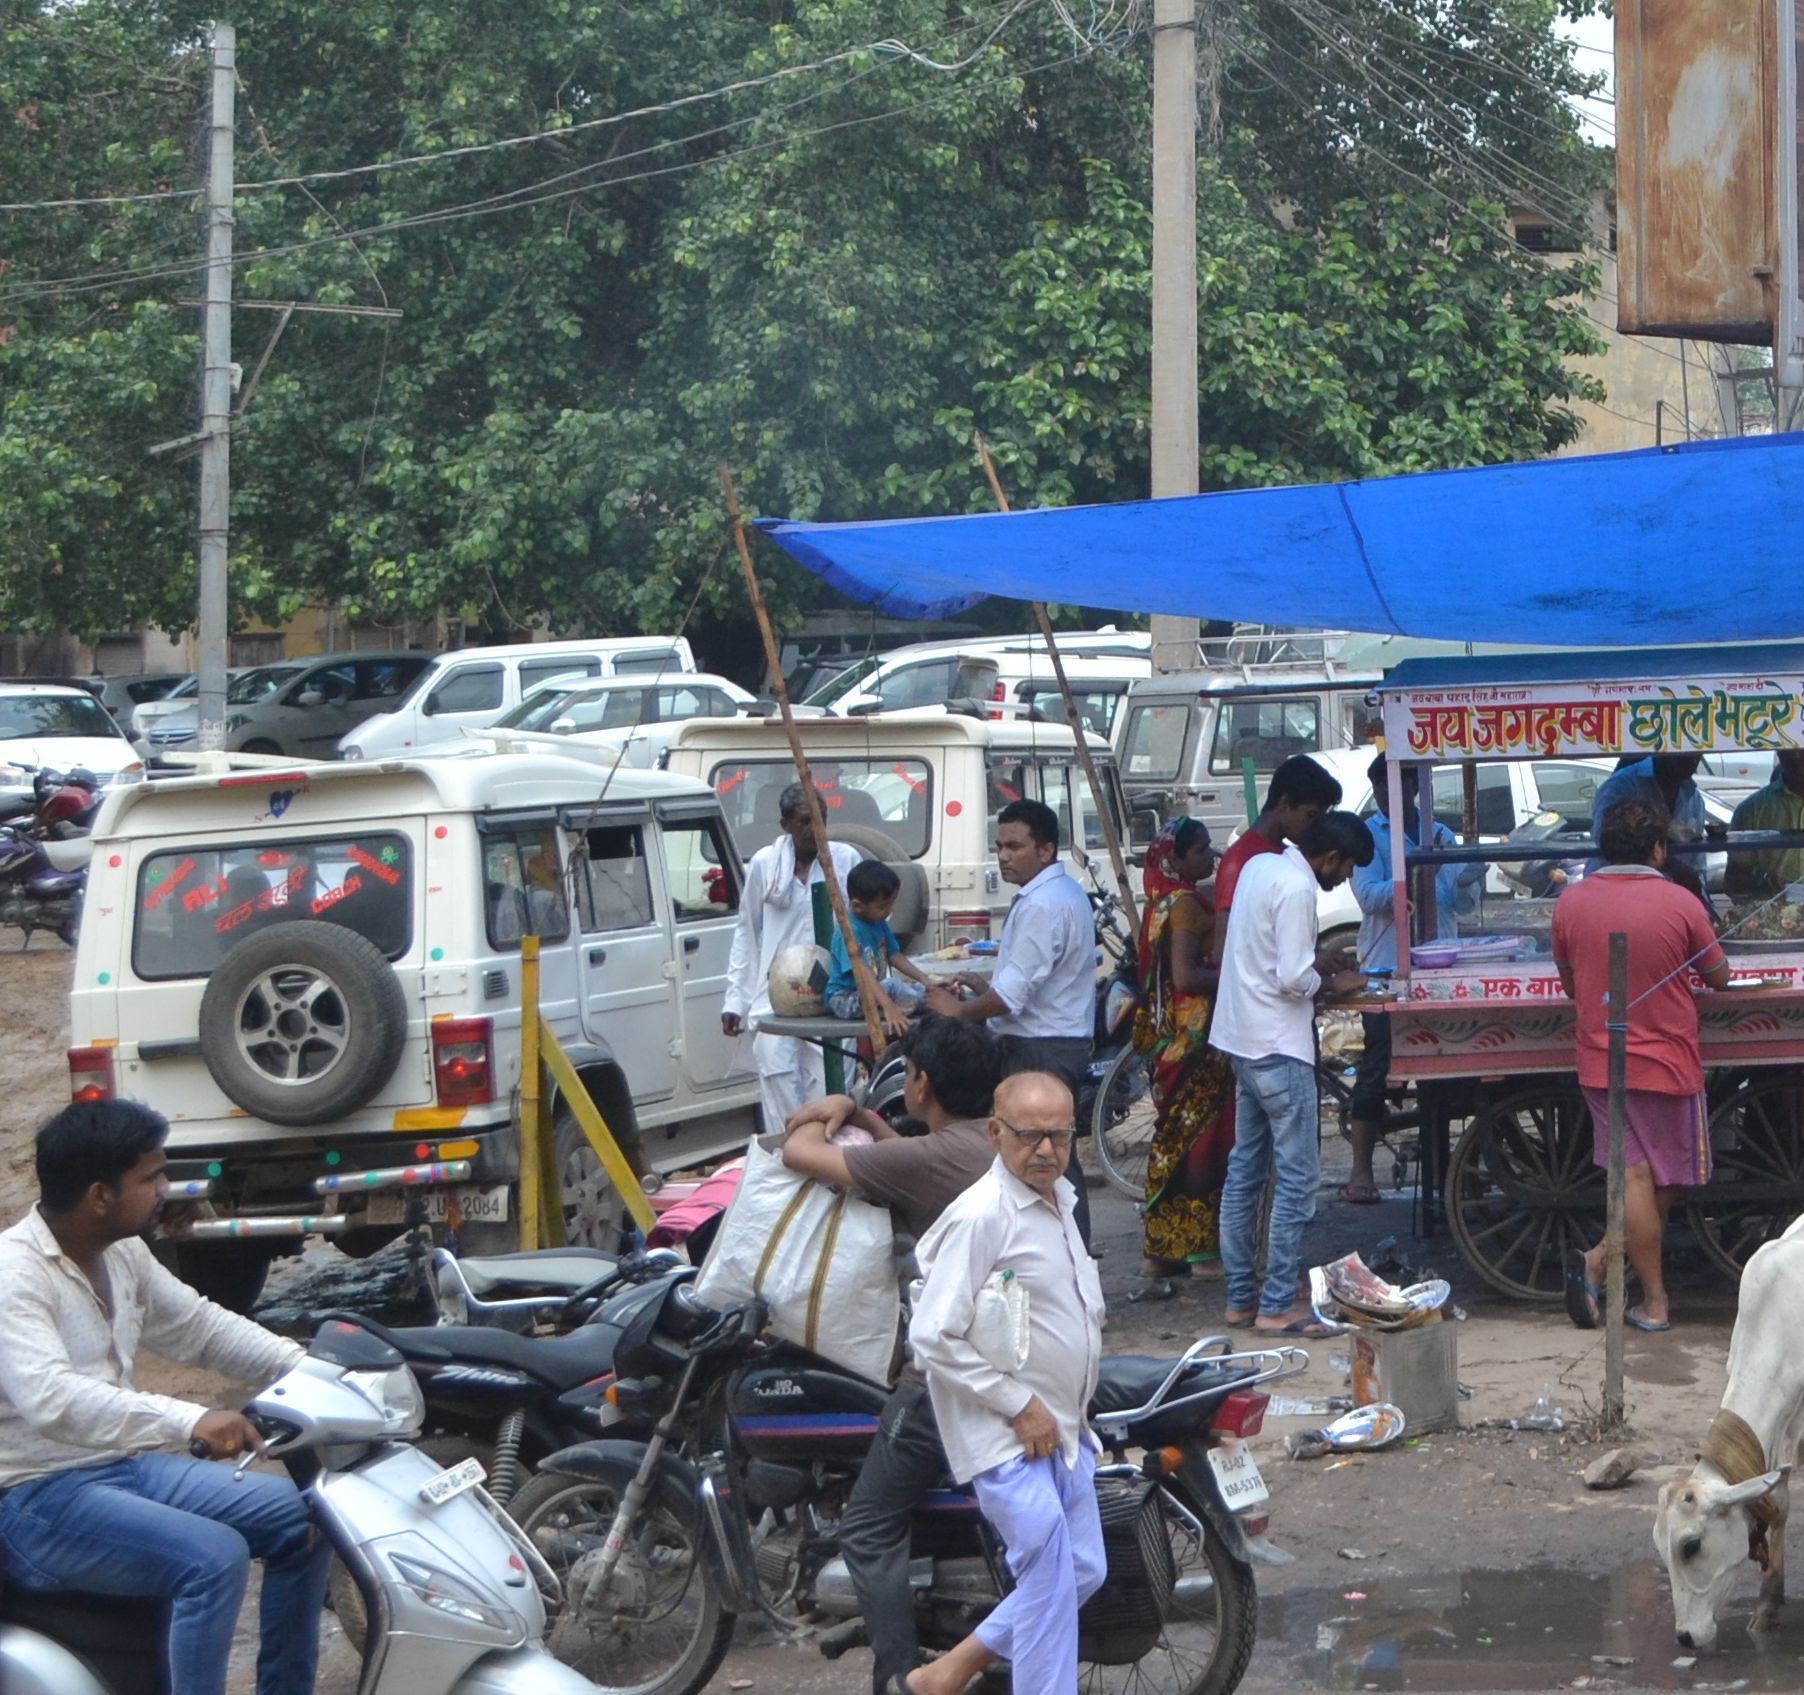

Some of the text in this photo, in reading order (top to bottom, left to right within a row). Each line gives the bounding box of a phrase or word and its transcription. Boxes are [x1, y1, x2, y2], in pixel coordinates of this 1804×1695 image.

[1408, 680, 1798, 757] जय जगदम्बा छोले भटूरे
[1479, 977, 1522, 998] एक
